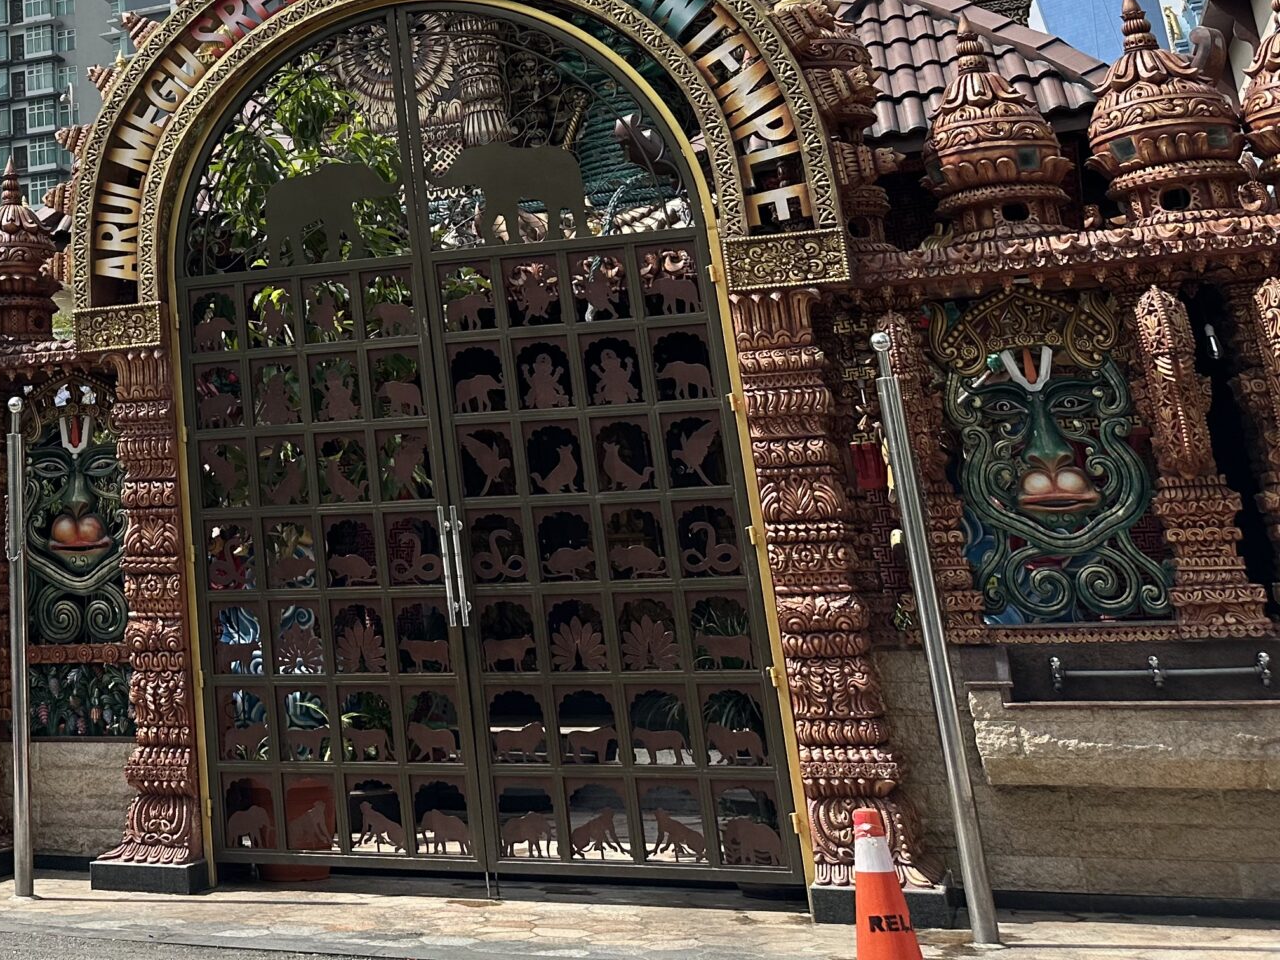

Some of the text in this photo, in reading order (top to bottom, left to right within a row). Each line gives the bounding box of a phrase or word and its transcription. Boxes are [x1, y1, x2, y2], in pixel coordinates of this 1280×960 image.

[109, 45, 205, 173] MEGU
[682, 3, 812, 227] TEMPLE
[96, 175, 146, 280] ARUL
